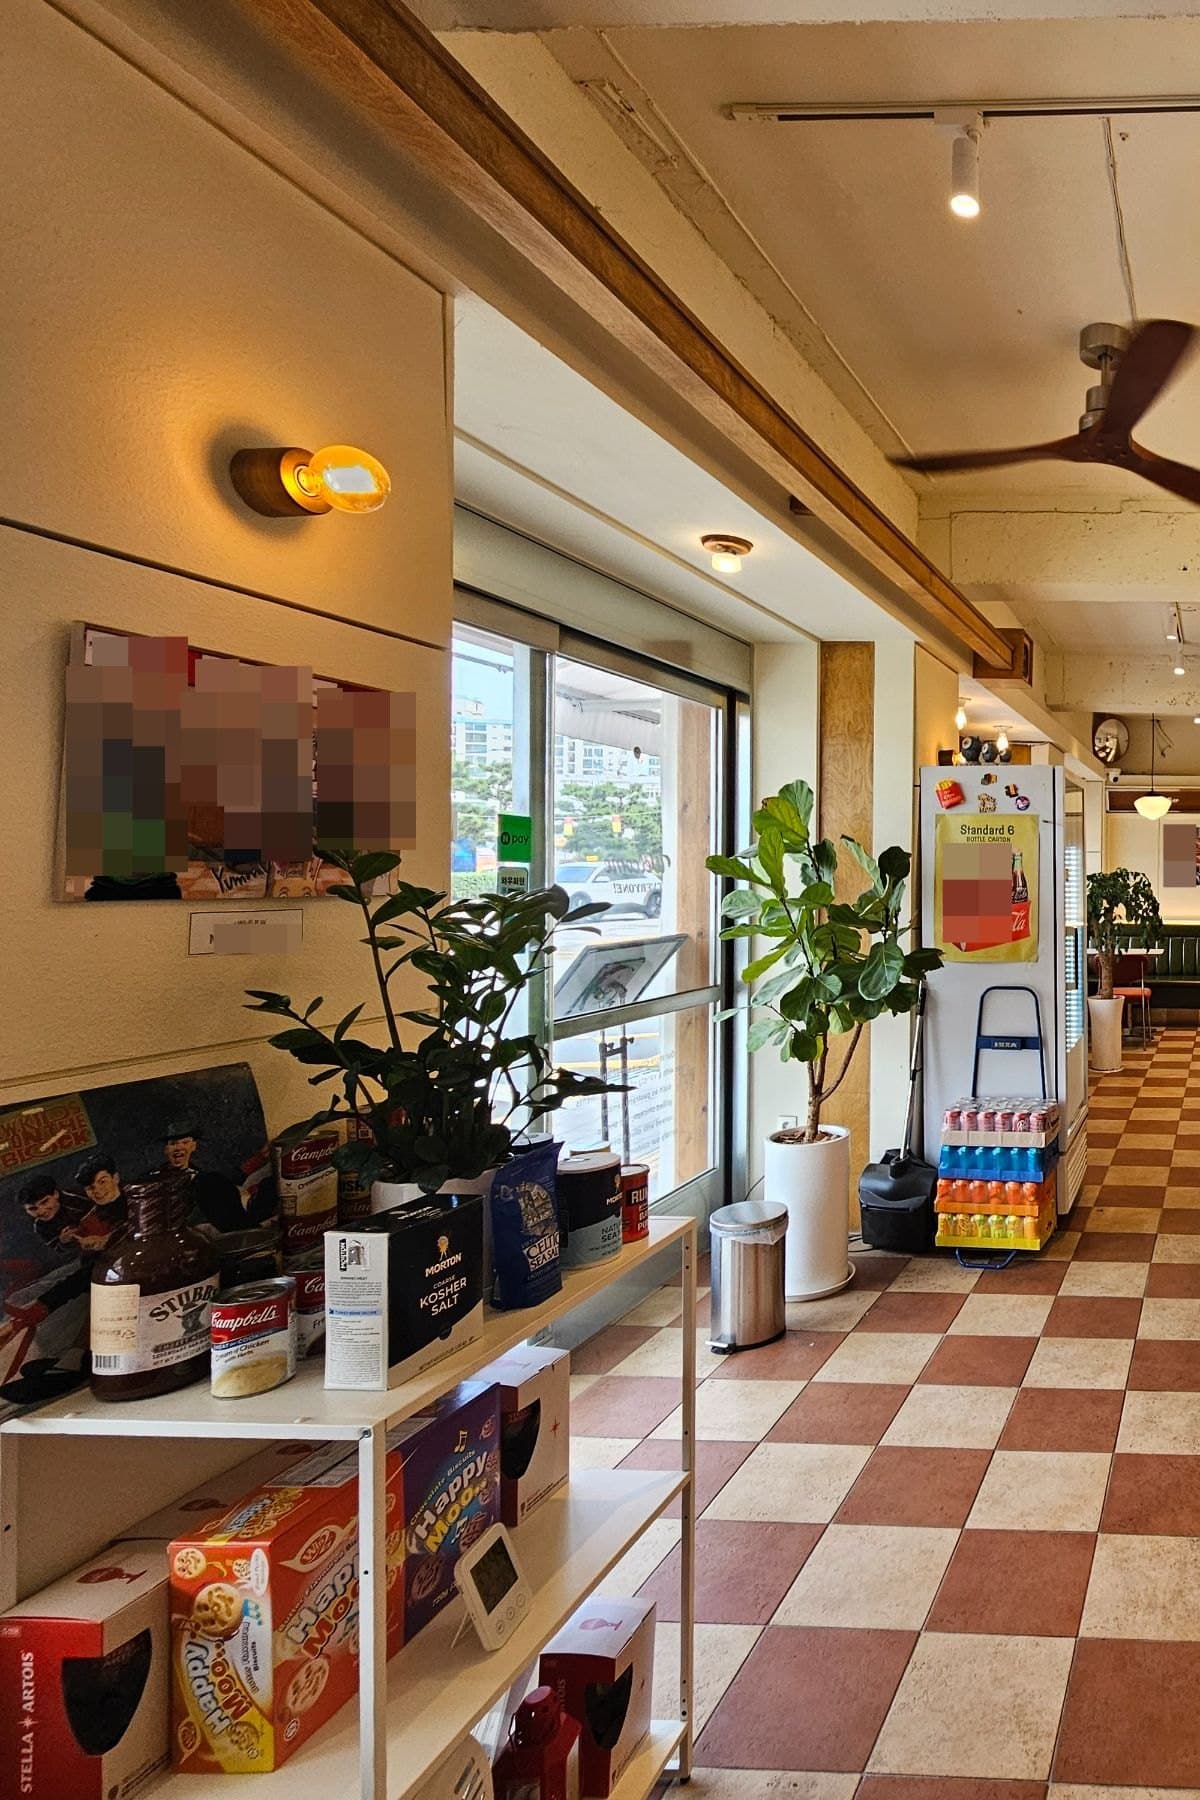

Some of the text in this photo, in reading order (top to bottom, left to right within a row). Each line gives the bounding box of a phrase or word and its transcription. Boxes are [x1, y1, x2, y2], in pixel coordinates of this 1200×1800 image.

[512, 836, 529, 844] pay
[960, 824, 1015, 836] Standard 6
[425, 1252, 462, 1277] MORTON
[419, 1277, 467, 1309] KOSHER
[431, 1293, 460, 1316] SALT
[211, 1305, 280, 1332] Campbell's
[239, 1339, 270, 1352] Chicken
[415, 1451, 488, 1541] Happy
[251, 1640, 260, 1672] Biscuits
[186, 1641, 233, 1737] Happy
[20, 1652, 35, 1793] STELLA ARTOIS
